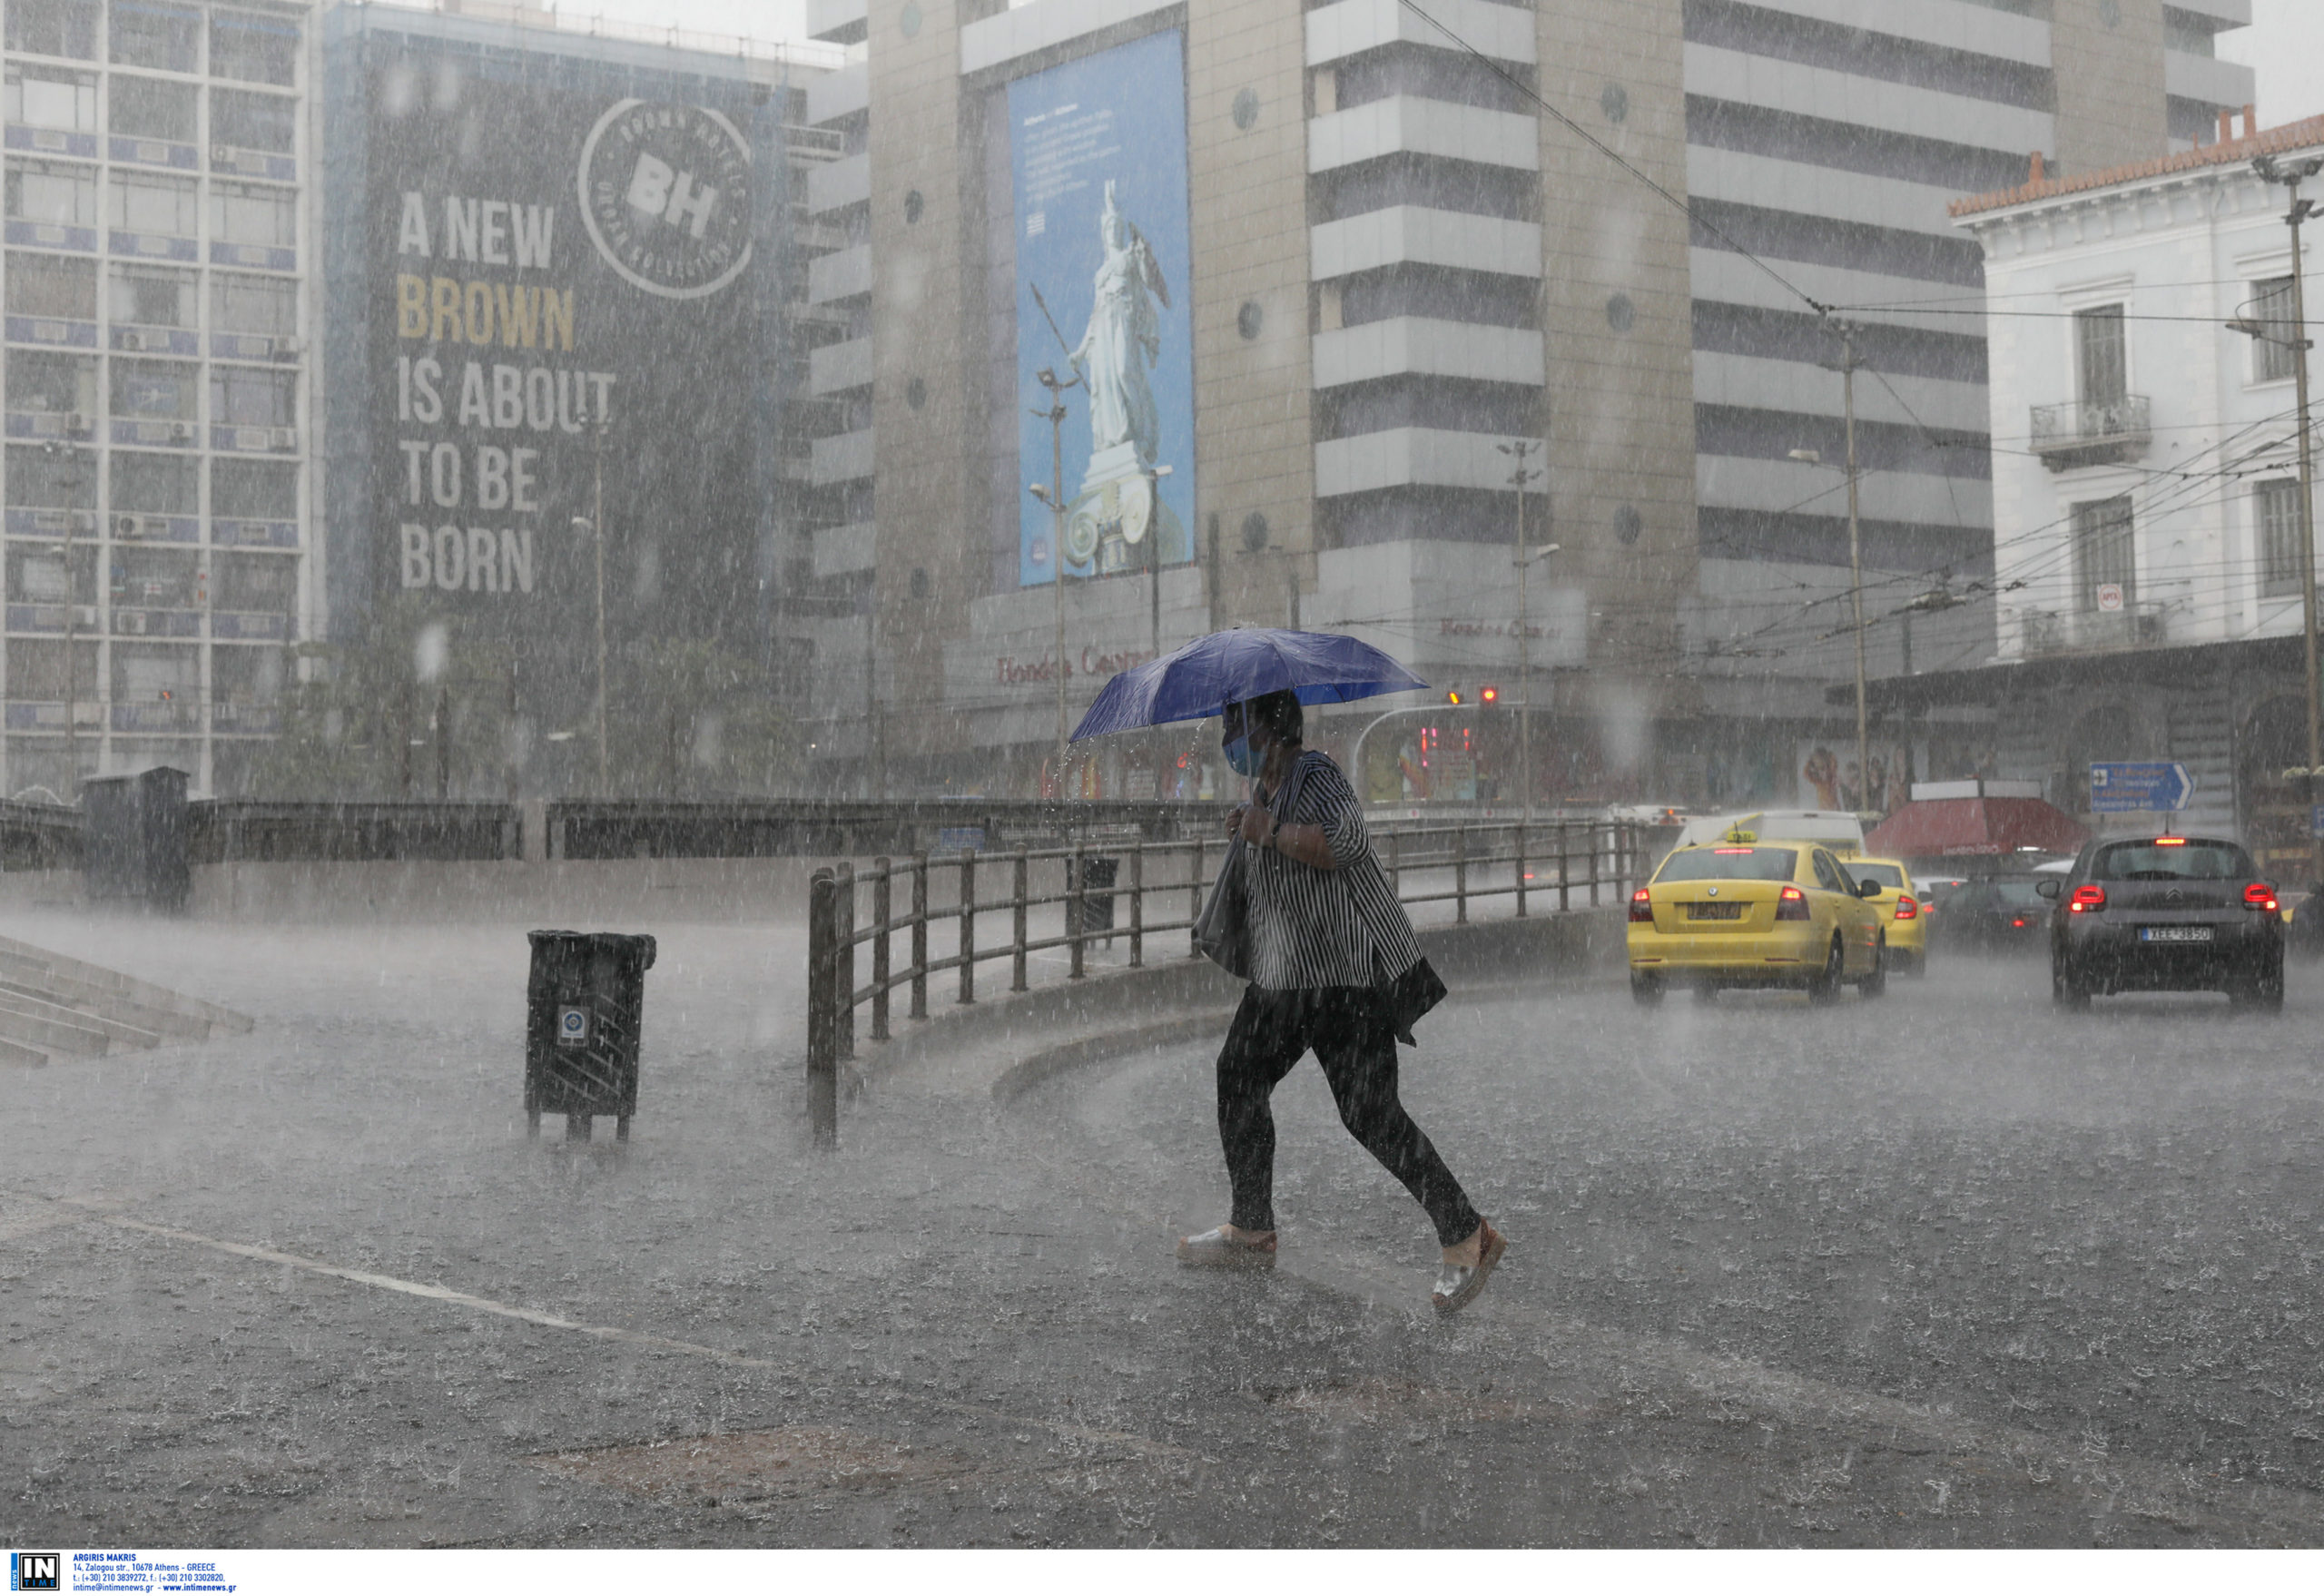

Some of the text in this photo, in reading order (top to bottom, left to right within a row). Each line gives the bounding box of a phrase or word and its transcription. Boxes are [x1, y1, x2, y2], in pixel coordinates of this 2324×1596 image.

[398, 192, 555, 269] A NEW
[626, 152, 717, 239] BH
[397, 273, 574, 352] BROWN
[399, 357, 617, 435] IS ABOUT
[400, 440, 540, 512] TO BE
[400, 523, 534, 593] BORN
